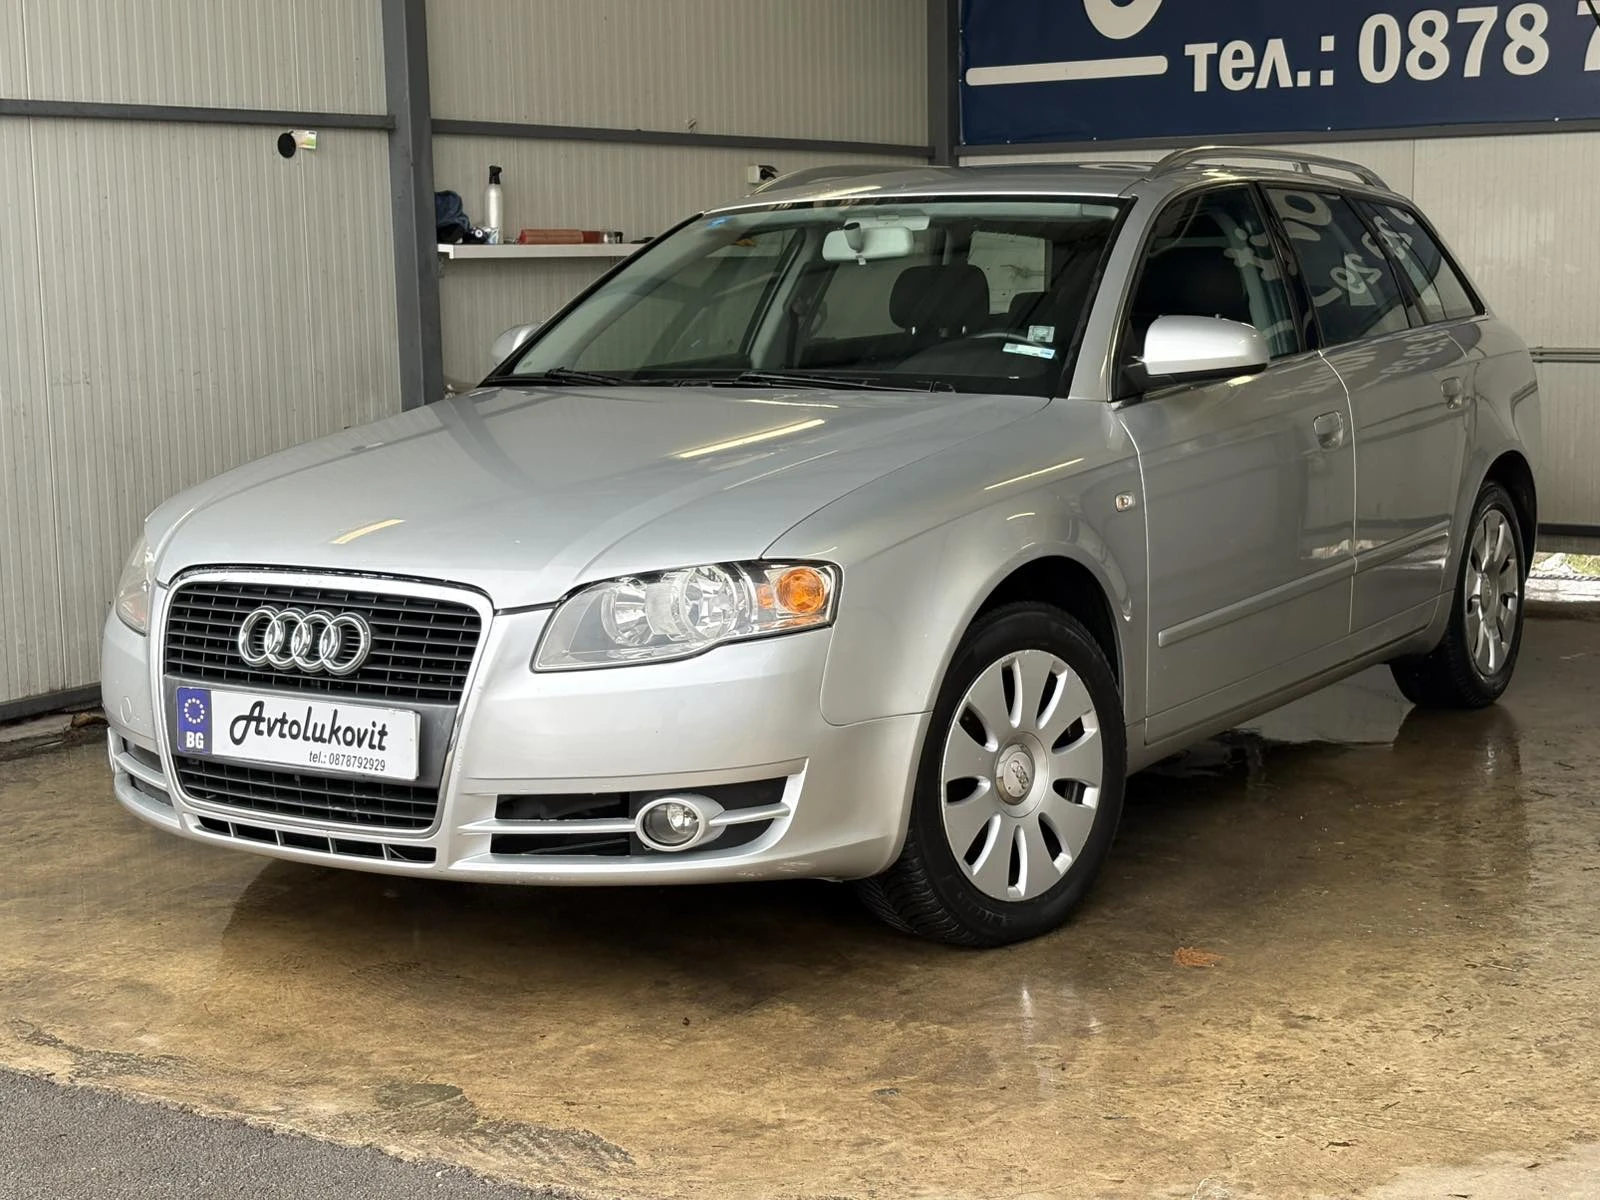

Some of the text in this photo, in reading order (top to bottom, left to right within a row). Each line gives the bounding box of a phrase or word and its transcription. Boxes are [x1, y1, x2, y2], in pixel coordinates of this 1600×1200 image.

[1184, 35, 1335, 92] тел.:
[1358, 2, 1550, 84] 0878
[185, 731, 205, 750] BG
[229, 700, 388, 752] Avtolukovit
[309, 750, 387, 772] tel.: 0878792929
